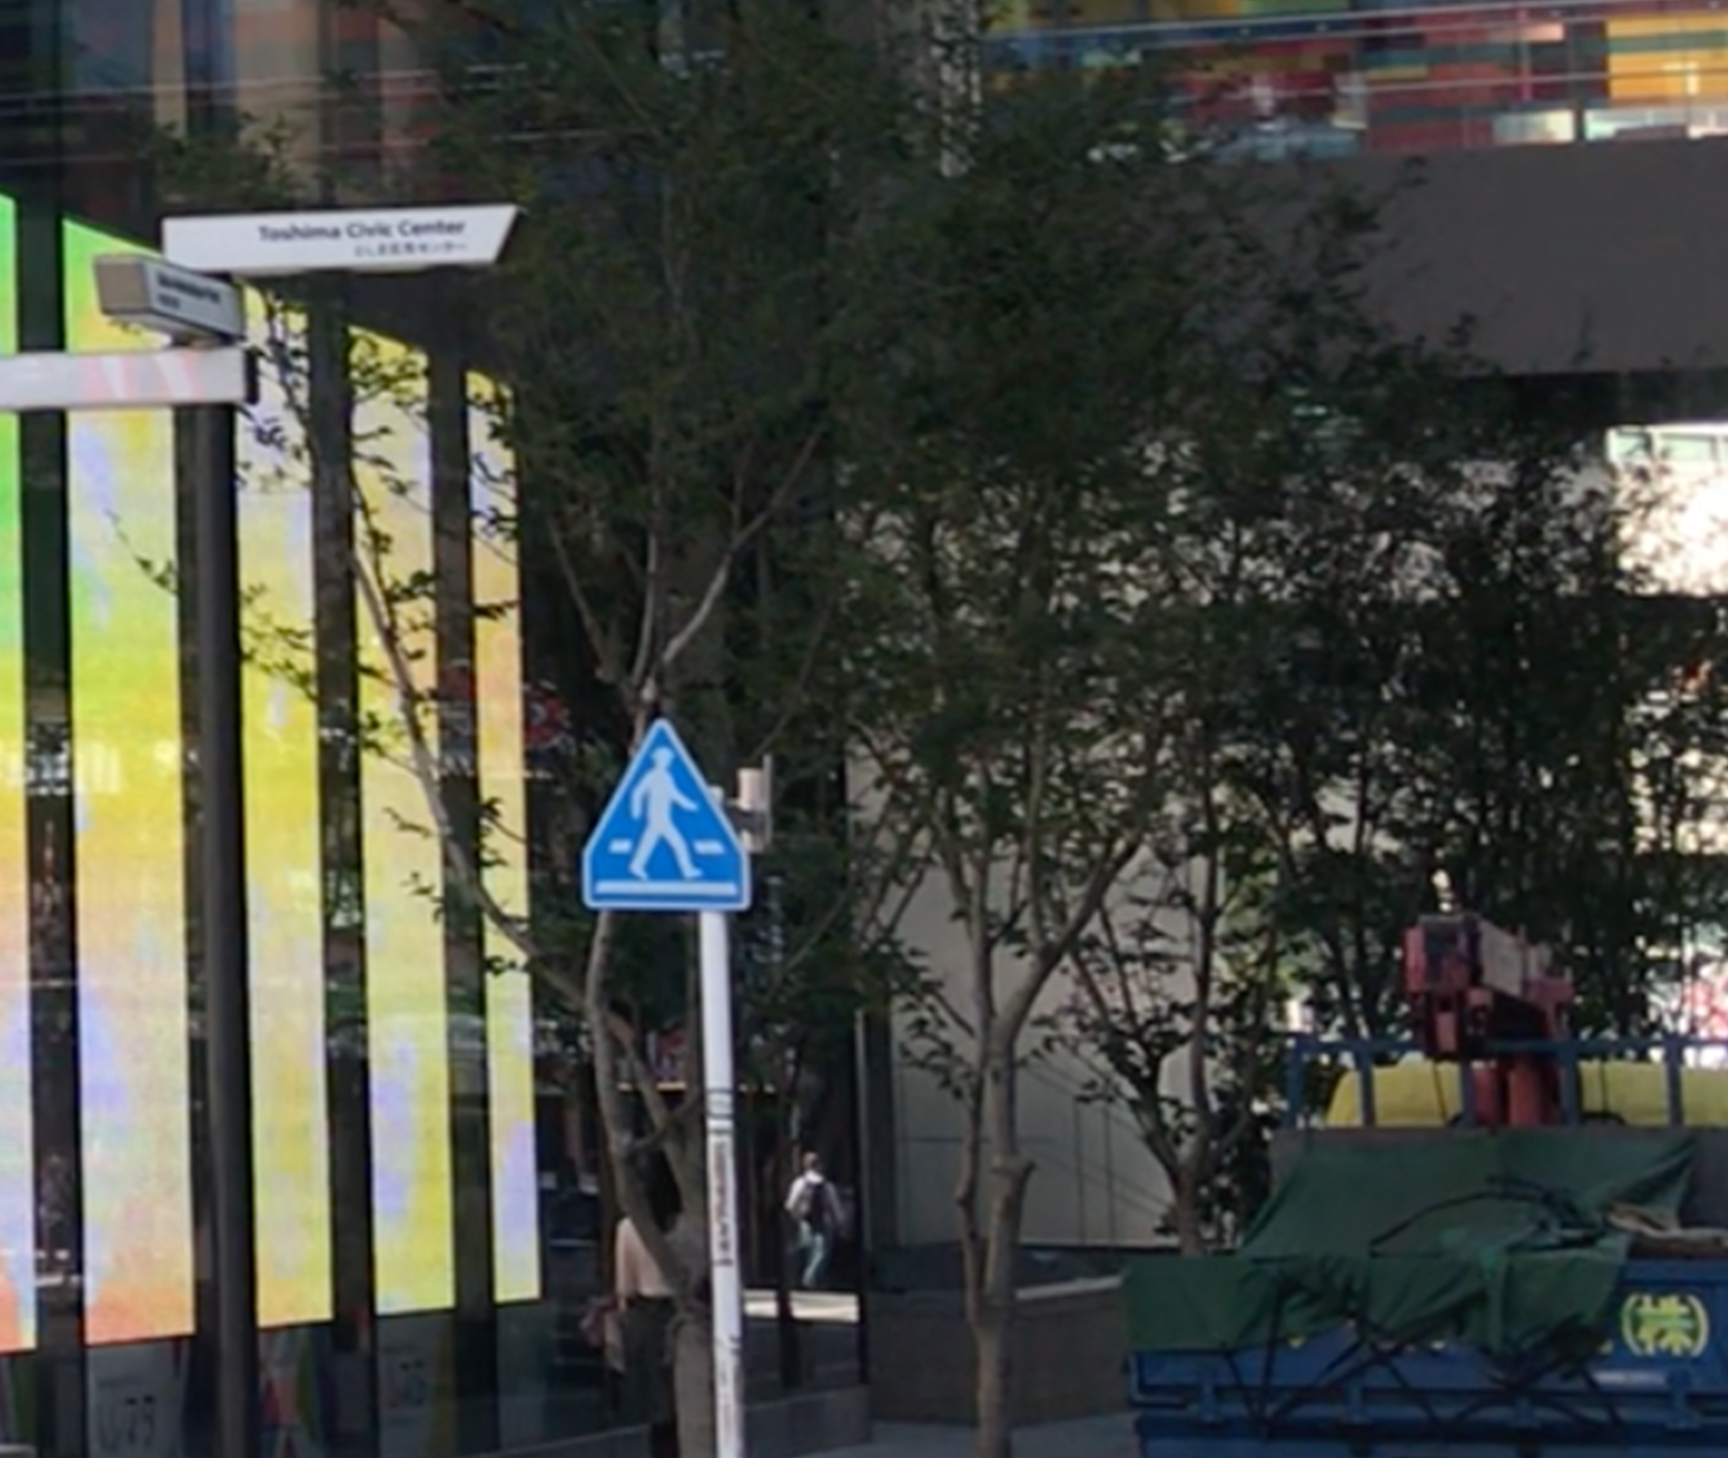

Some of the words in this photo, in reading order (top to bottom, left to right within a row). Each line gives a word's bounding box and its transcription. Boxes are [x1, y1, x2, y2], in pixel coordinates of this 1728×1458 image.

[258, 224, 341, 242] Toshima
[345, 222, 393, 239] Civic
[397, 219, 466, 236] Center
